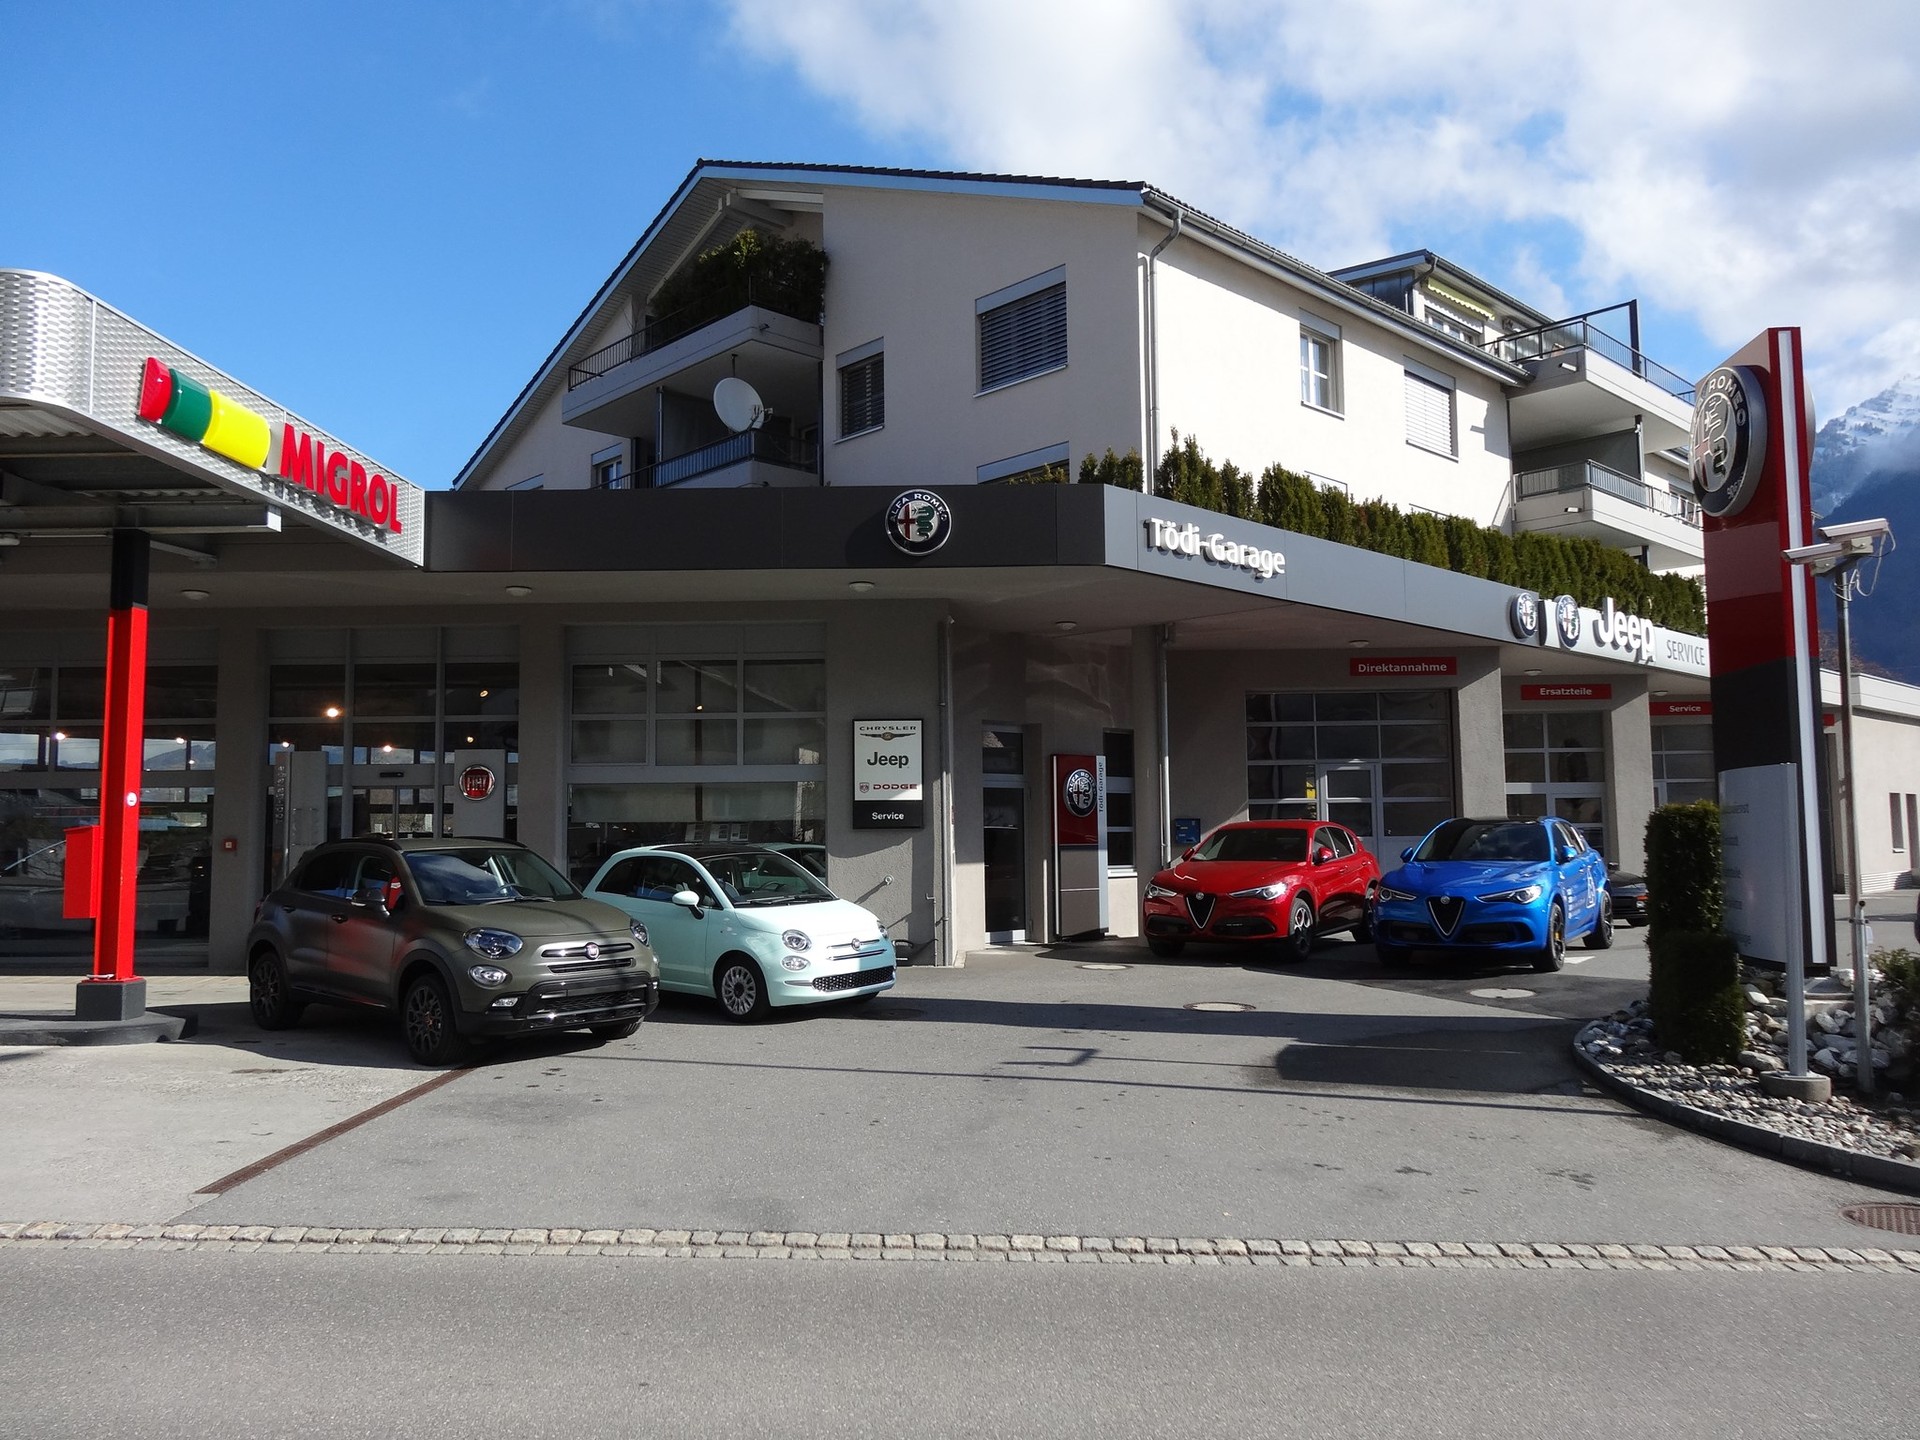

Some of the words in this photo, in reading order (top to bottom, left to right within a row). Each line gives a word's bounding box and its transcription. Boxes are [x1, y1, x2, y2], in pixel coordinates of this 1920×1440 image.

[1708, 375, 1746, 427] ROMEO
[280, 422, 402, 535] MIGROL
[890, 496, 910, 522] ALFA
[913, 493, 948, 521] ROMEO
[1150, 517, 1286, 579] Tödi-Garage
[1597, 596, 1656, 663] Jeep
[1666, 639, 1706, 667] SERVICE
[1358, 663, 1447, 673] Direktannahme
[1539, 687, 1593, 696] Ersatzteile
[1669, 705, 1702, 713] Service
[866, 751, 910, 769] Jeep
[871, 811, 905, 820] Service
